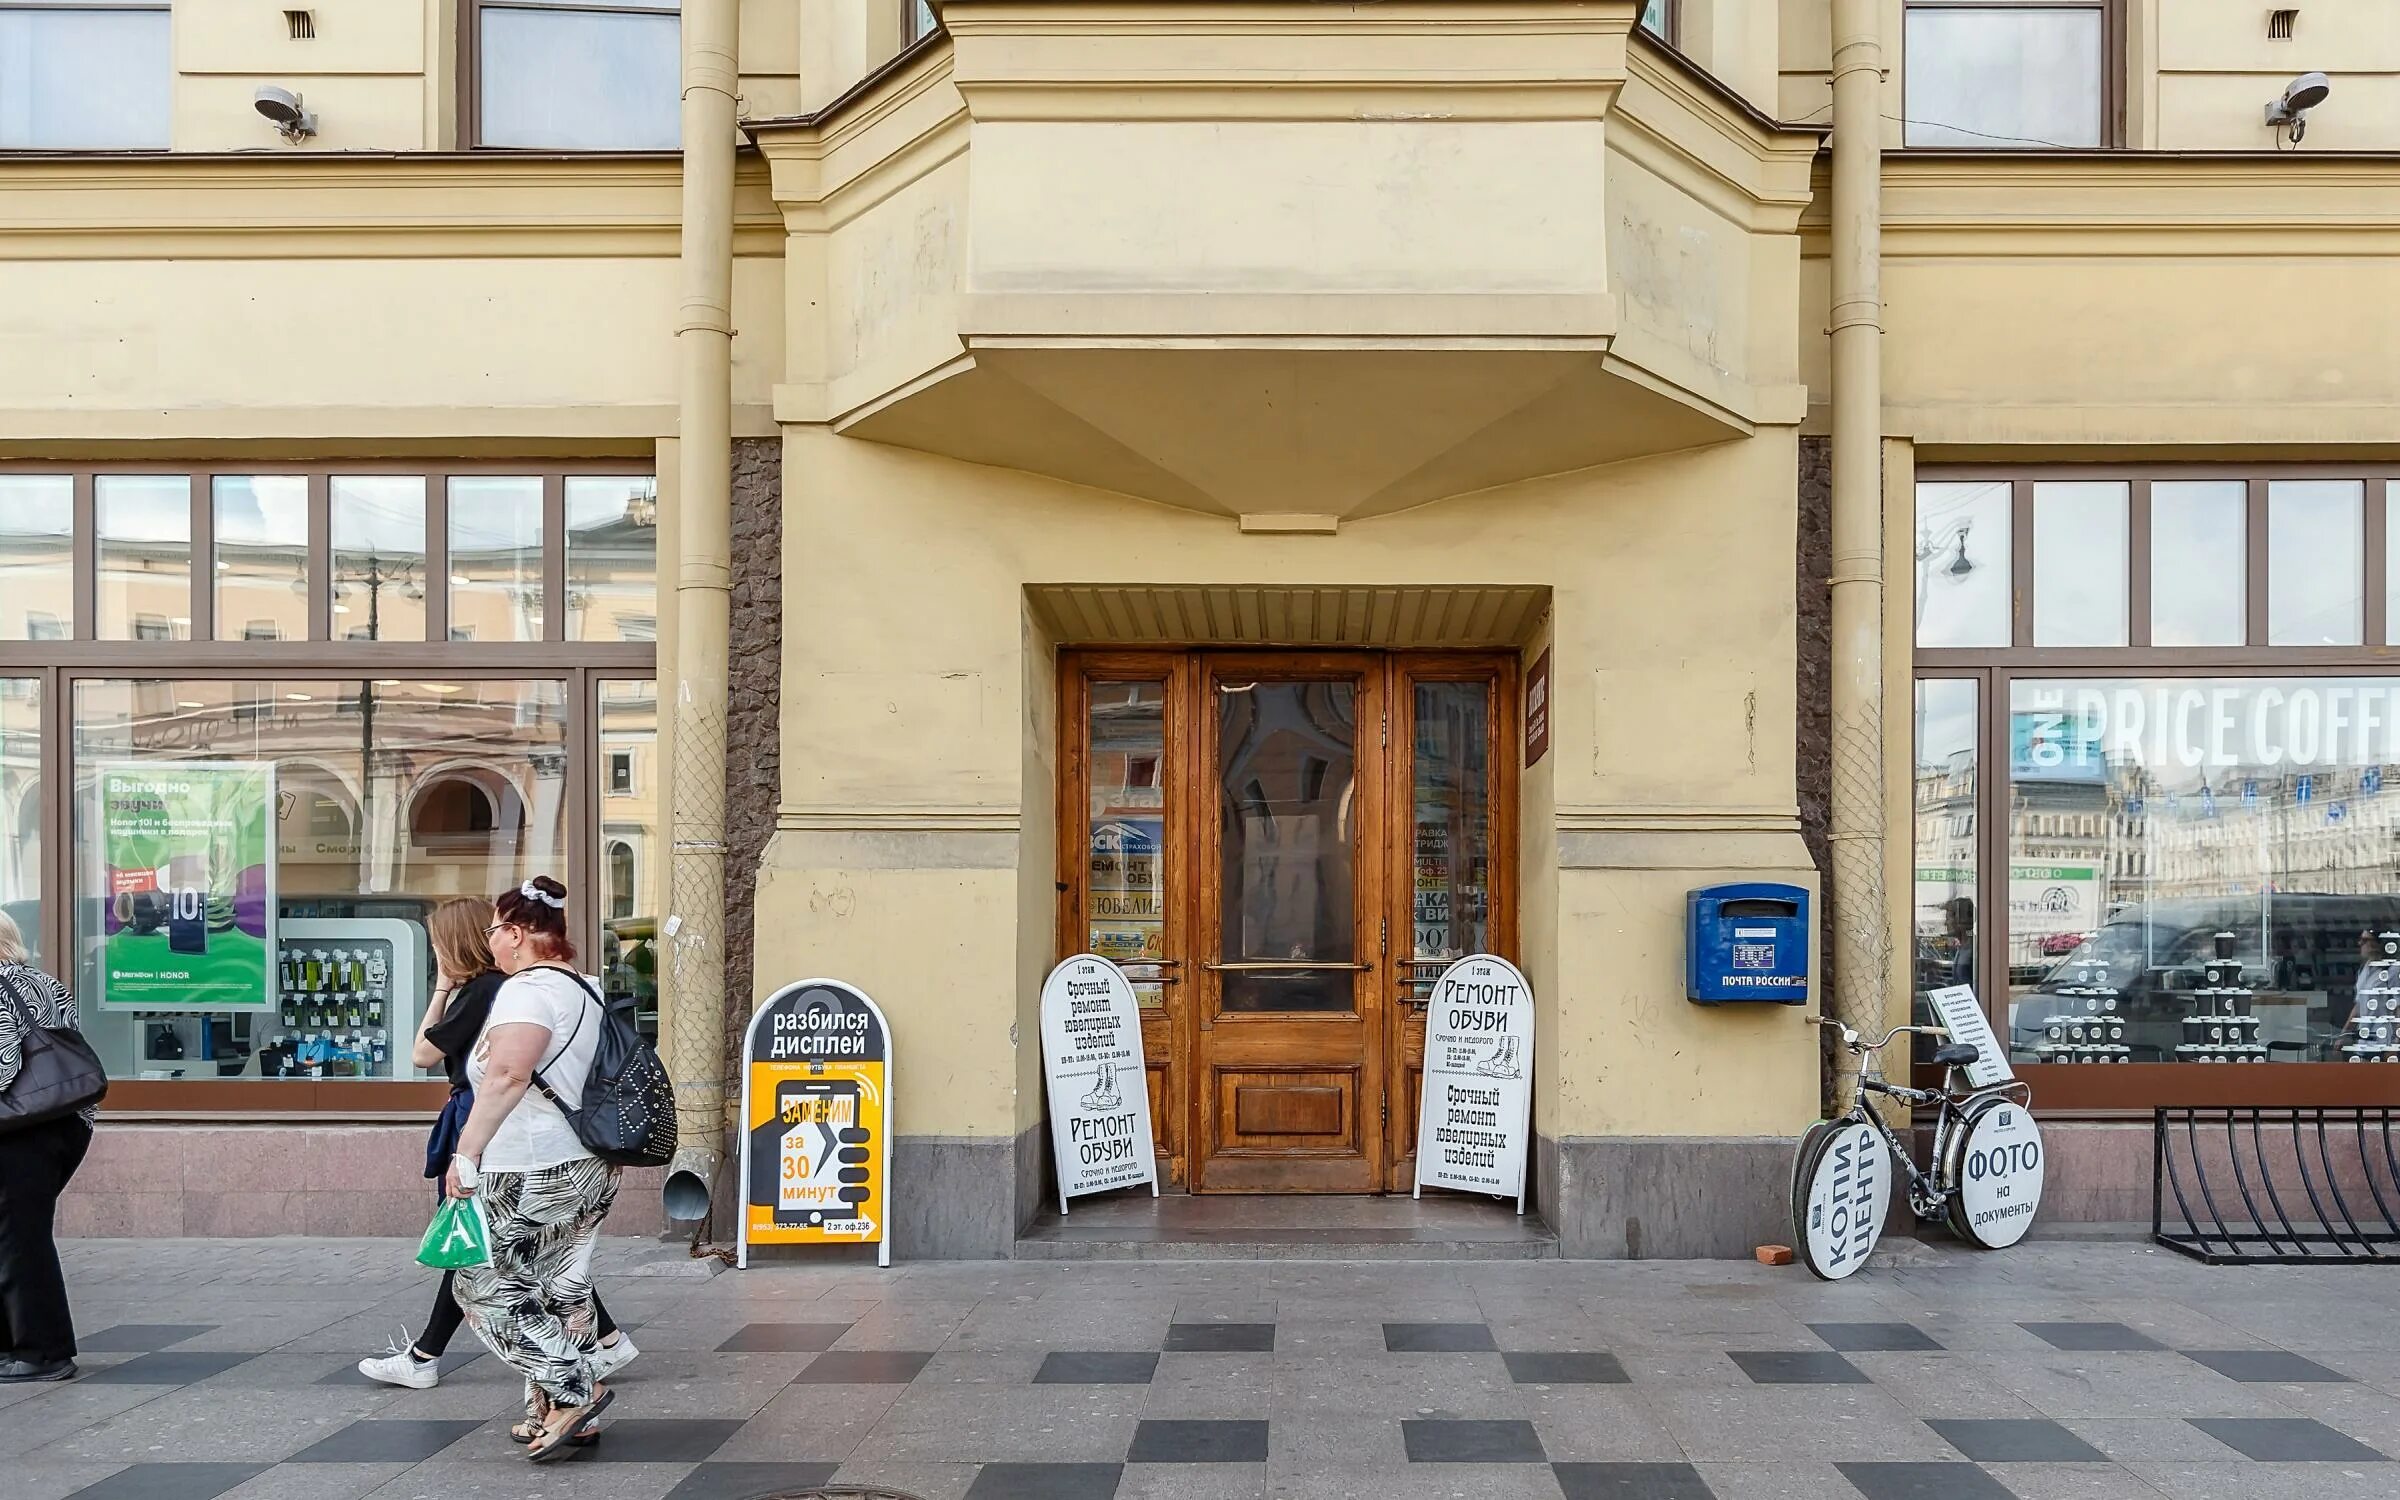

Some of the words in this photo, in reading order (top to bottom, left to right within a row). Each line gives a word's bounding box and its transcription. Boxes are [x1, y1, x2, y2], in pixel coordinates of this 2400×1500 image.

[2032, 687, 2064, 767] ONE
[2076, 688, 2239, 766] PRICE
[110, 779, 190, 795] Выгодно
[110, 818, 138, 826] Honor
[172, 887, 203, 921] 10i
[160, 971, 190, 979] HONOR
[1081, 965, 1096, 976] этаж
[1476, 966, 1491, 976] этаж
[1722, 975, 1753, 986] ПОЧТА
[1755, 975, 1791, 986] РОССИИ
[1066, 978, 1111, 998] Срочный
[1070, 999, 1112, 1015] ремонт
[773, 1007, 869, 1036] разбился
[1064, 1015, 1122, 1036] ювелирных
[1449, 1009, 1508, 1032] ОБУВИ
[770, 1030, 866, 1058] дисплей
[1073, 1030, 1116, 1051] изделий
[1447, 1083, 1500, 1108] Срочный
[782, 1099, 853, 1124] ЗАМЕНИМ
[1447, 1109, 1496, 1128] ремонт
[785, 1135, 805, 1149] за
[1436, 1128, 1507, 1149] ювелирных
[1080, 1137, 1134, 1165] ОБУВИ
[1444, 1145, 1495, 1169] изделий
[1967, 1140, 2040, 1182] ФОТО
[782, 1155, 810, 1180] 30
[783, 1185, 837, 1203] минут
[1853, 1129, 1876, 1260] ЦЕНТР
[1996, 1184, 2011, 1199] на
[1830, 1142, 1853, 1268] КОПИ
[1974, 1202, 2034, 1229] документы
[827, 1222, 832, 1231] 2
